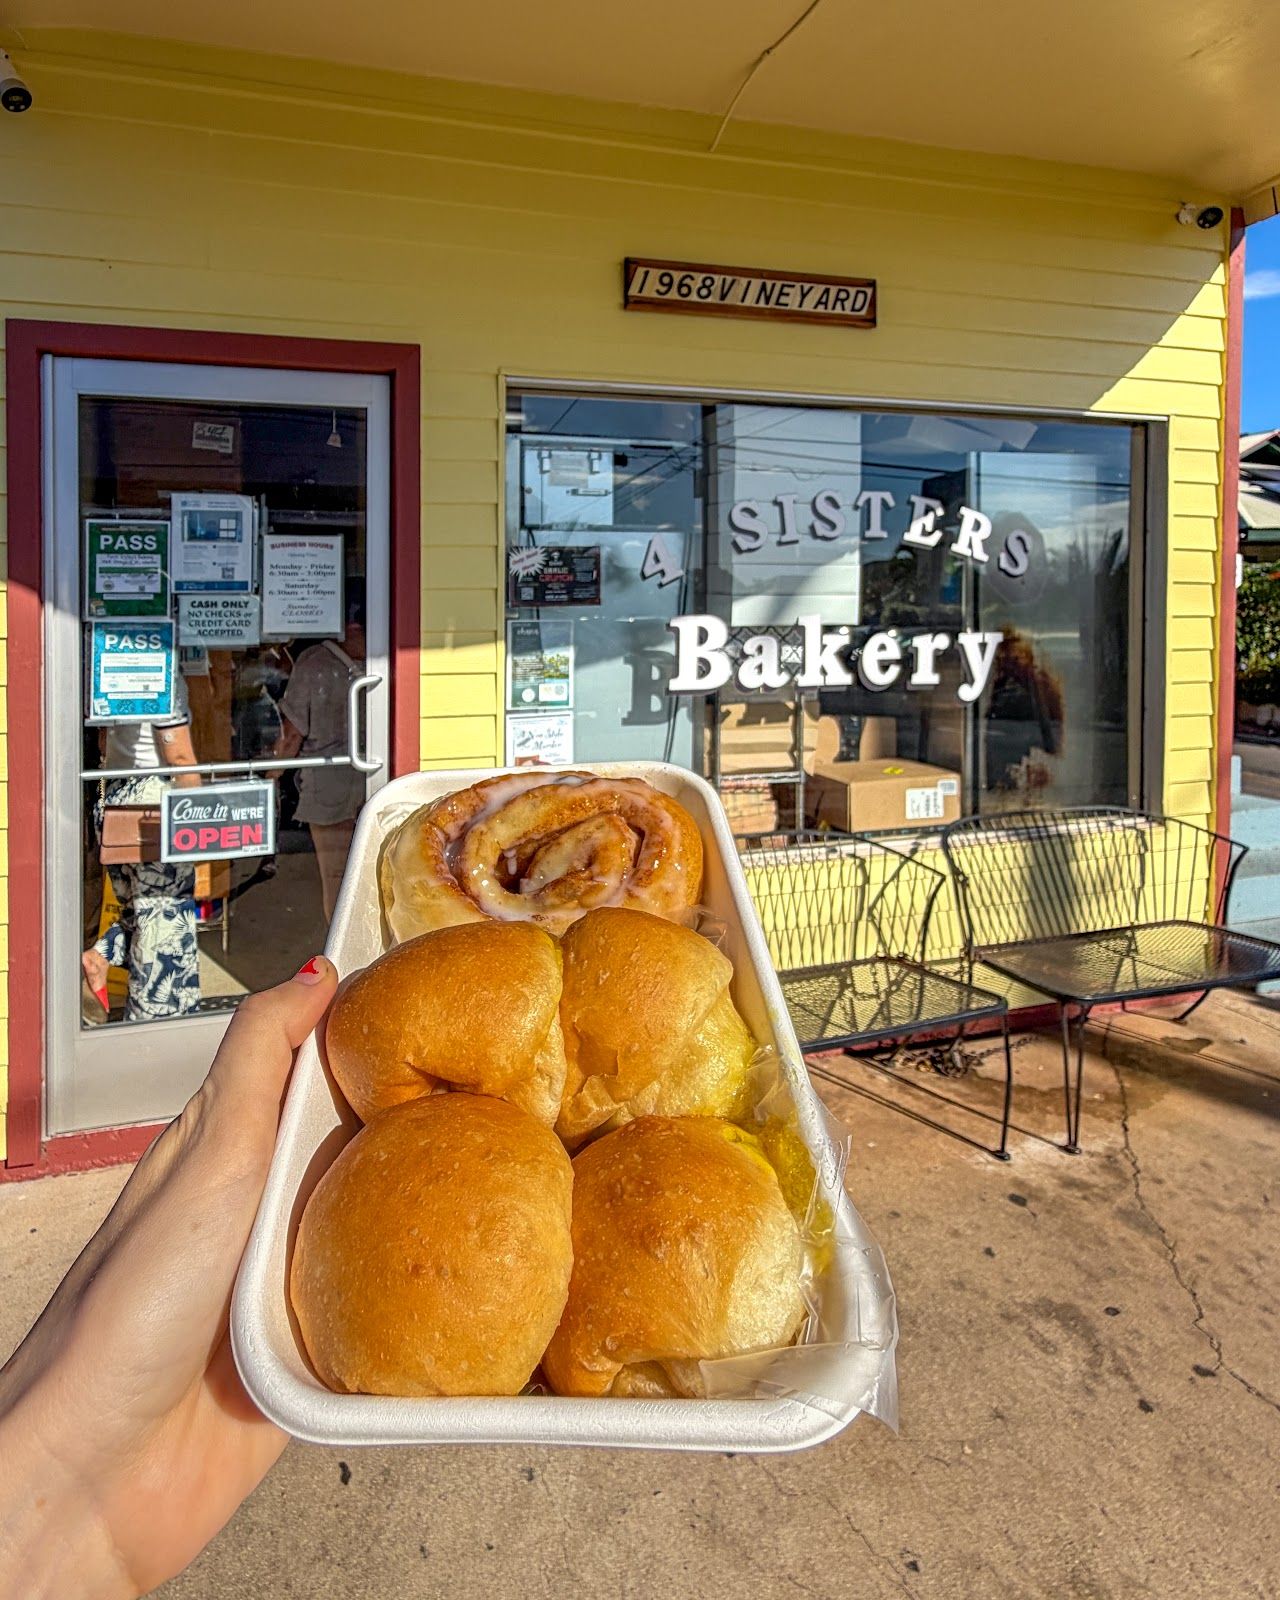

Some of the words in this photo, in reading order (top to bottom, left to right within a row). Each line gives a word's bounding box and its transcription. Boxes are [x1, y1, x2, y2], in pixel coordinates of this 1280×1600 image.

[99, 534, 158, 551] PASS
[270, 541, 307, 550] BUSINESS
[308, 541, 334, 550] HOURS
[641, 532, 683, 587] 4
[730, 489, 1034, 578] SISTERS
[190, 600, 218, 609] CASH
[221, 600, 250, 609] ONLY
[187, 610, 202, 618] NO
[204, 610, 241, 618] CHECKS
[188, 619, 223, 628] CREDIT
[225, 619, 251, 628] CARD
[104, 633, 162, 650] PASS
[668, 614, 1004, 702] Bakery
[172, 798, 212, 821] Come
[213, 803, 229, 819] in
[231, 805, 264, 821] WE'RE
[173, 823, 263, 851] OPEN
